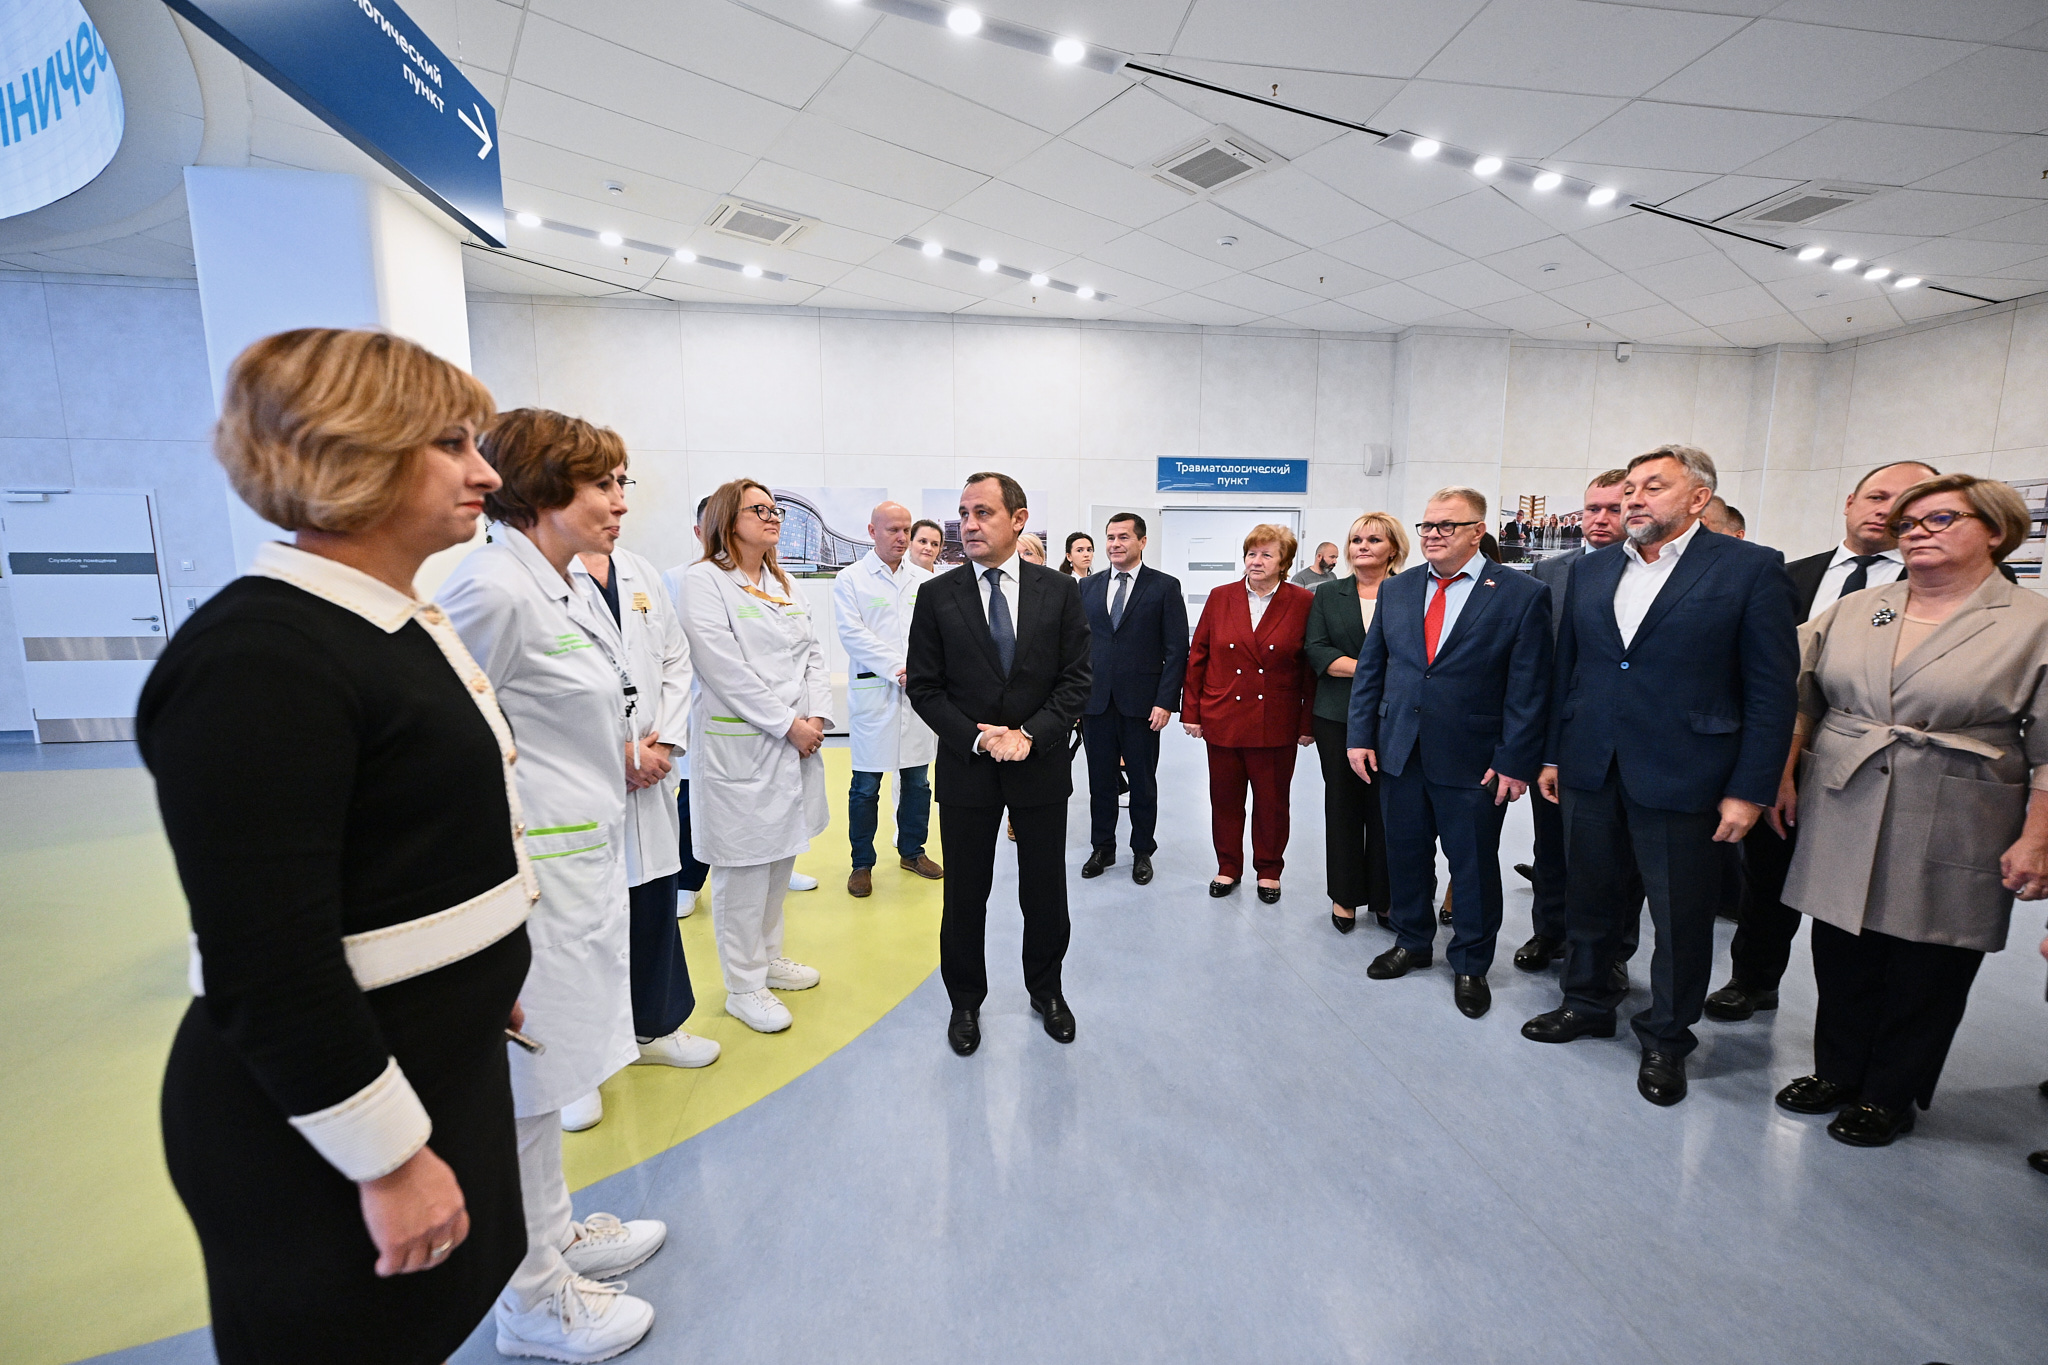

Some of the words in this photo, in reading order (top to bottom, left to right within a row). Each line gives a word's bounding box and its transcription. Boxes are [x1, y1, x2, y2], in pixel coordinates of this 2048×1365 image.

[403, 63, 444, 113] пункт
[1175, 462, 1290, 474] Травматологический
[1217, 477, 1250, 487] пункт
